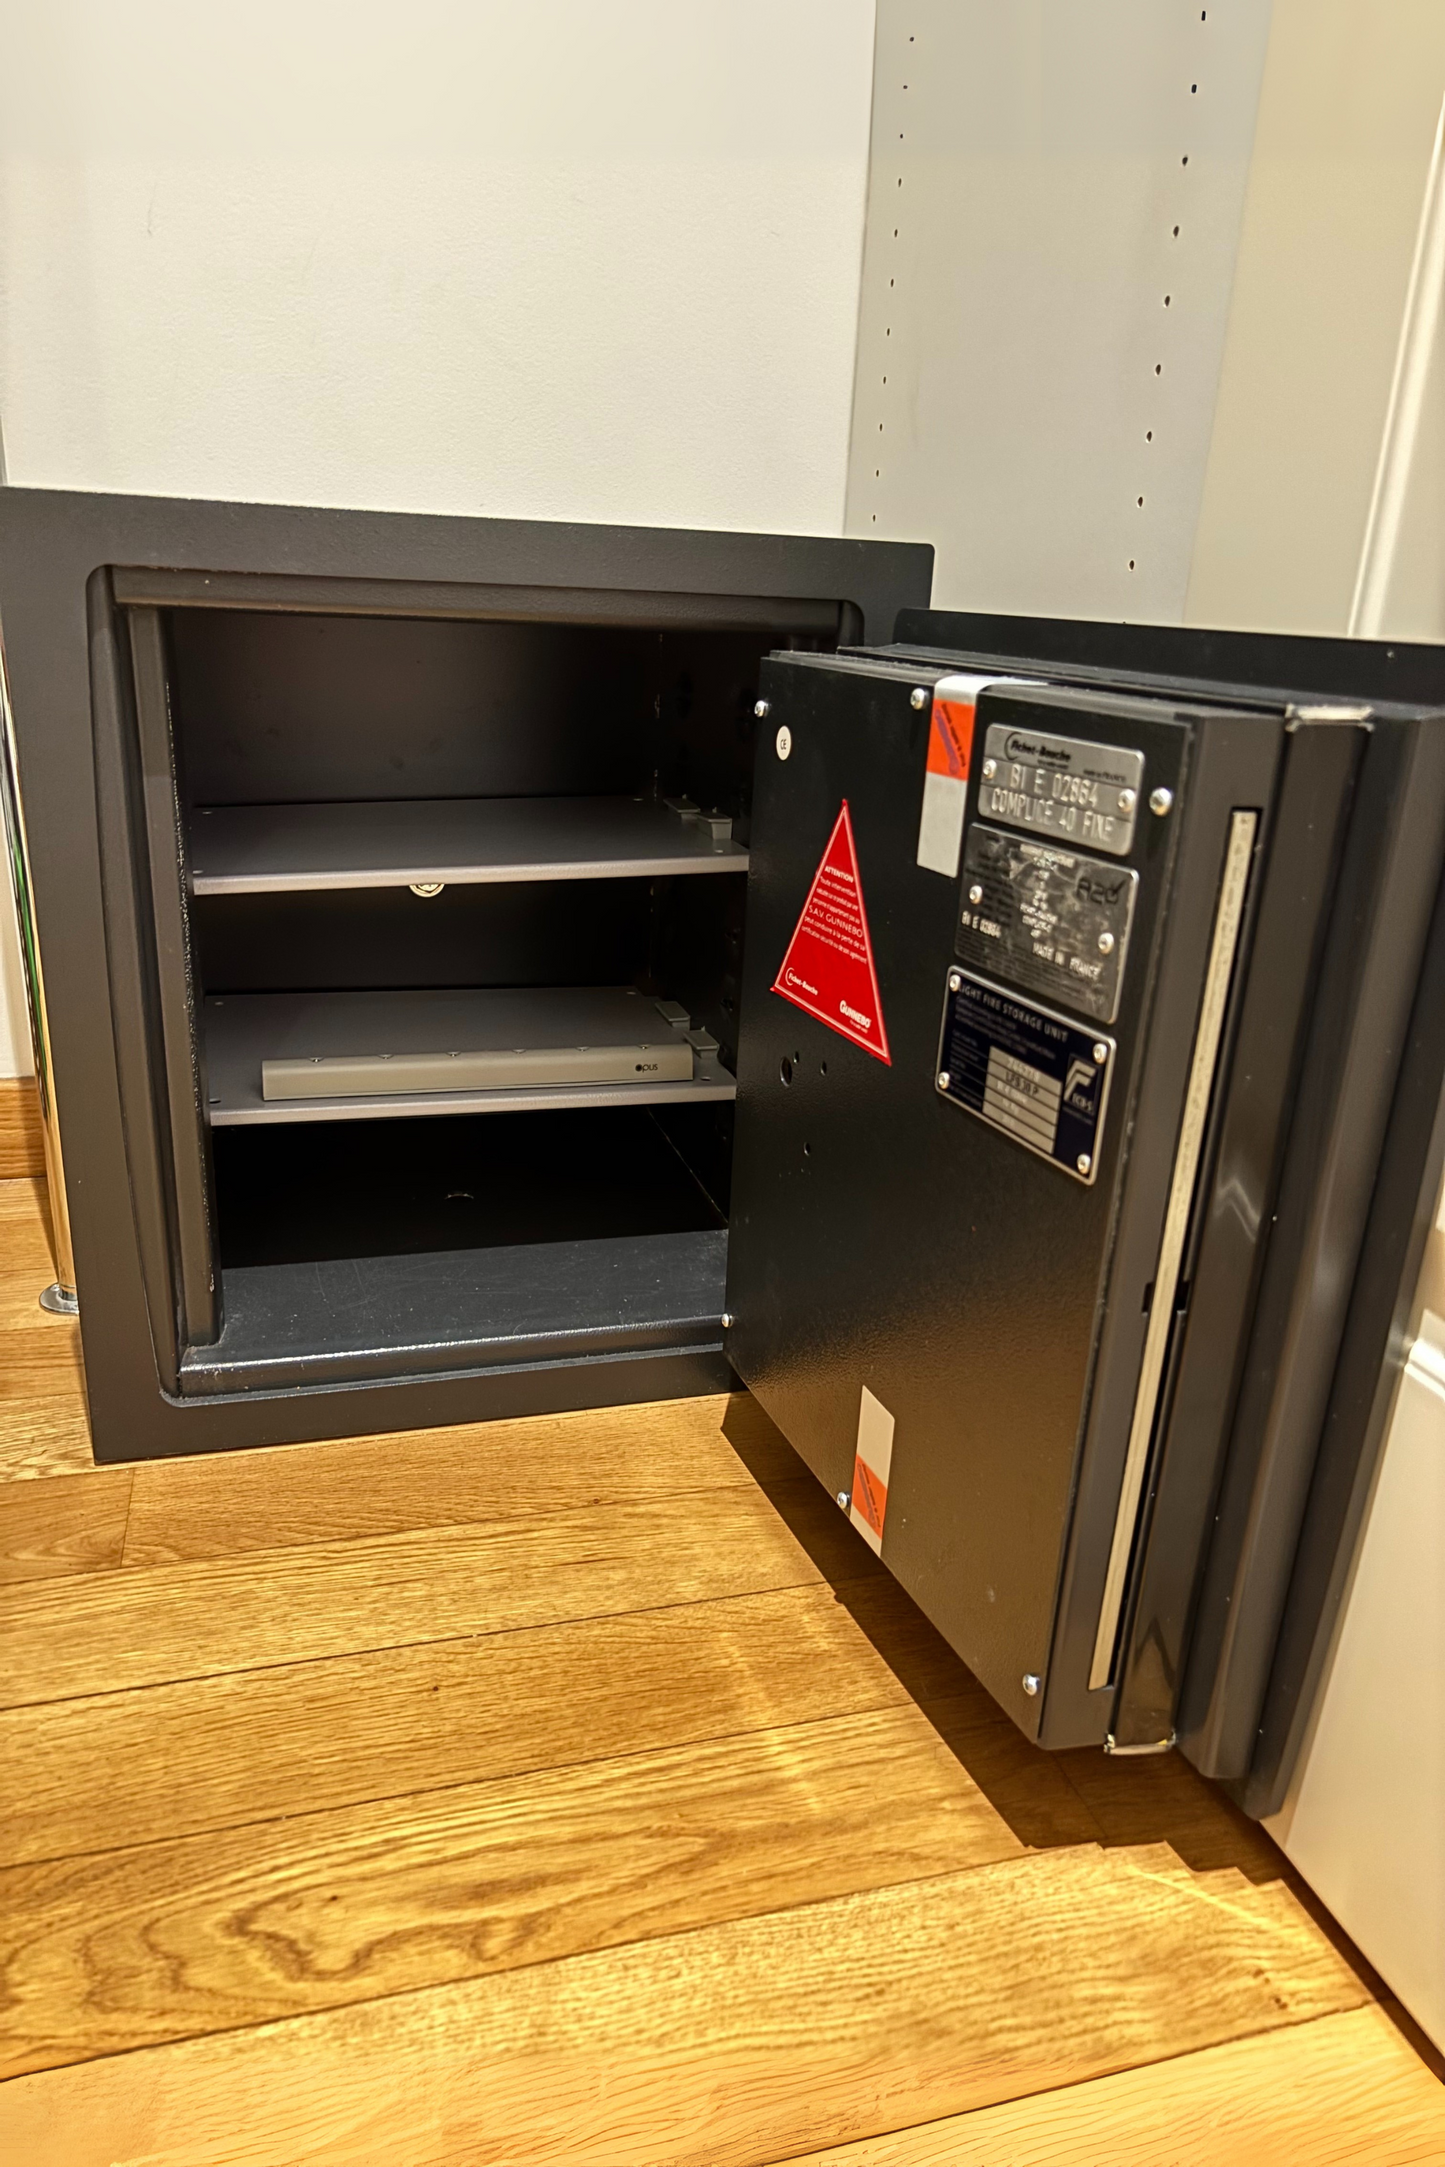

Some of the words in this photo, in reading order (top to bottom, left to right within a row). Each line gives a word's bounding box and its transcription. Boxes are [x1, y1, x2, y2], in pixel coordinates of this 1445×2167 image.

[780, 739, 787, 750] CE
[1034, 768, 1045, 794] E
[991, 788, 1054, 825] COMPLICE
[1059, 806, 1077, 831] 40
[1083, 810, 1114, 842] FIXE
[824, 866, 854, 883] ATTENTION
[826, 913, 862, 938] GUNNEBO
[959, 983, 981, 1001] LIGHT
[983, 993, 1000, 1010] FIRE
[1003, 1003, 1042, 1031] STORAGE
[1044, 1022, 1068, 1043] UNIT
